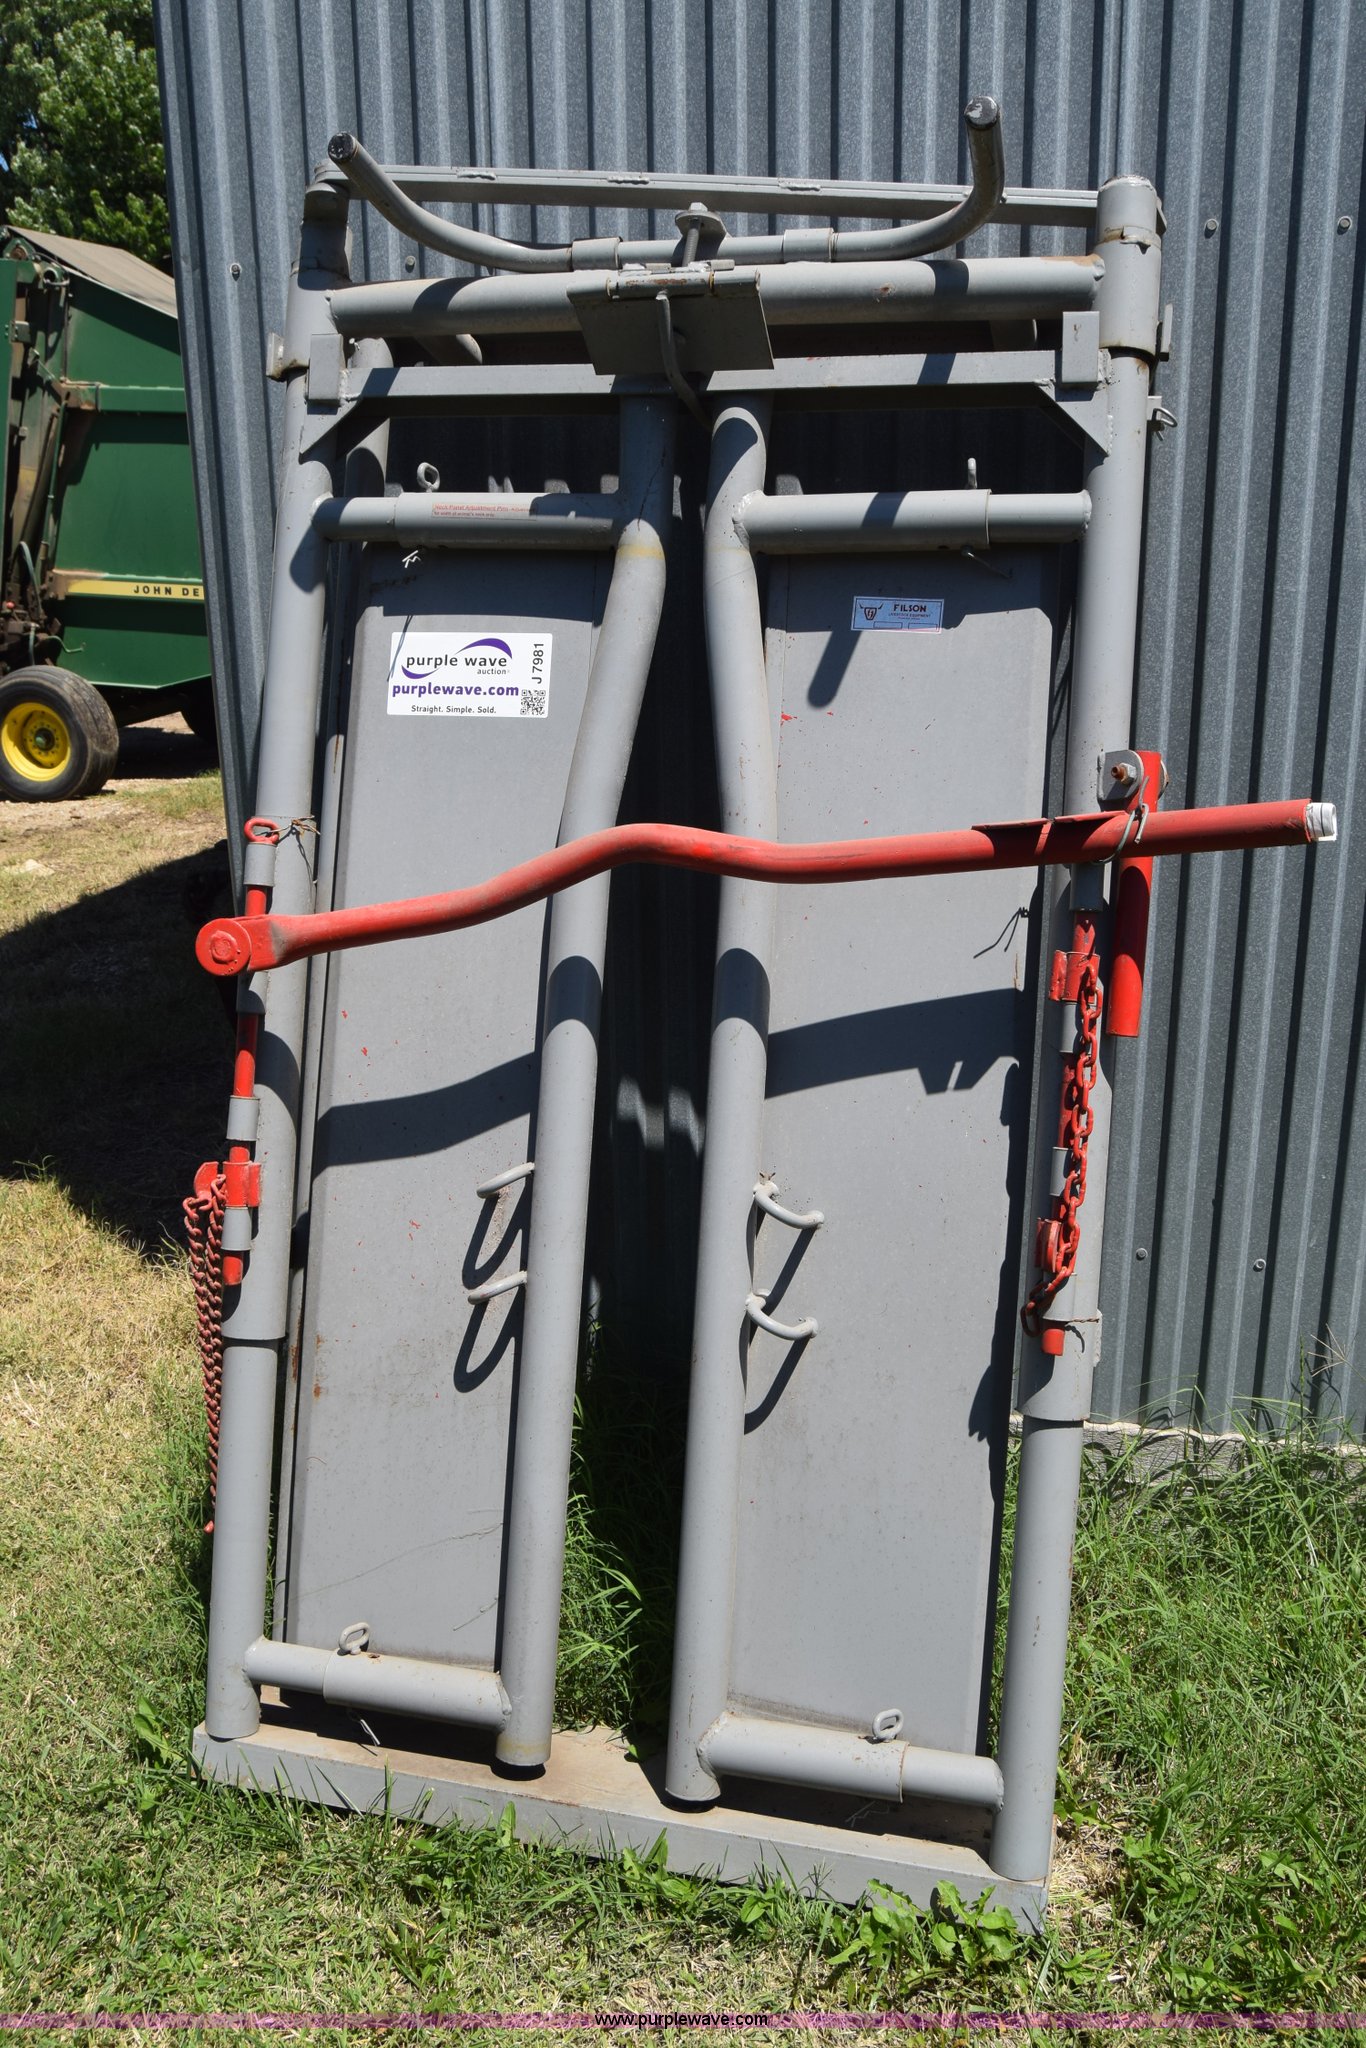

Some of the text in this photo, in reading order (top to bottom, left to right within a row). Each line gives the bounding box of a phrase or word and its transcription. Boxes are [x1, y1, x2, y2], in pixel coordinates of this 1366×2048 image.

[133, 585, 172, 596] JOHN
[893, 603, 927, 613] FILSON
[406, 654, 507, 669] purple wave
[392, 682, 519, 698] purplewave.com
[411, 704, 497, 715] Straight. Simple. Sold.
